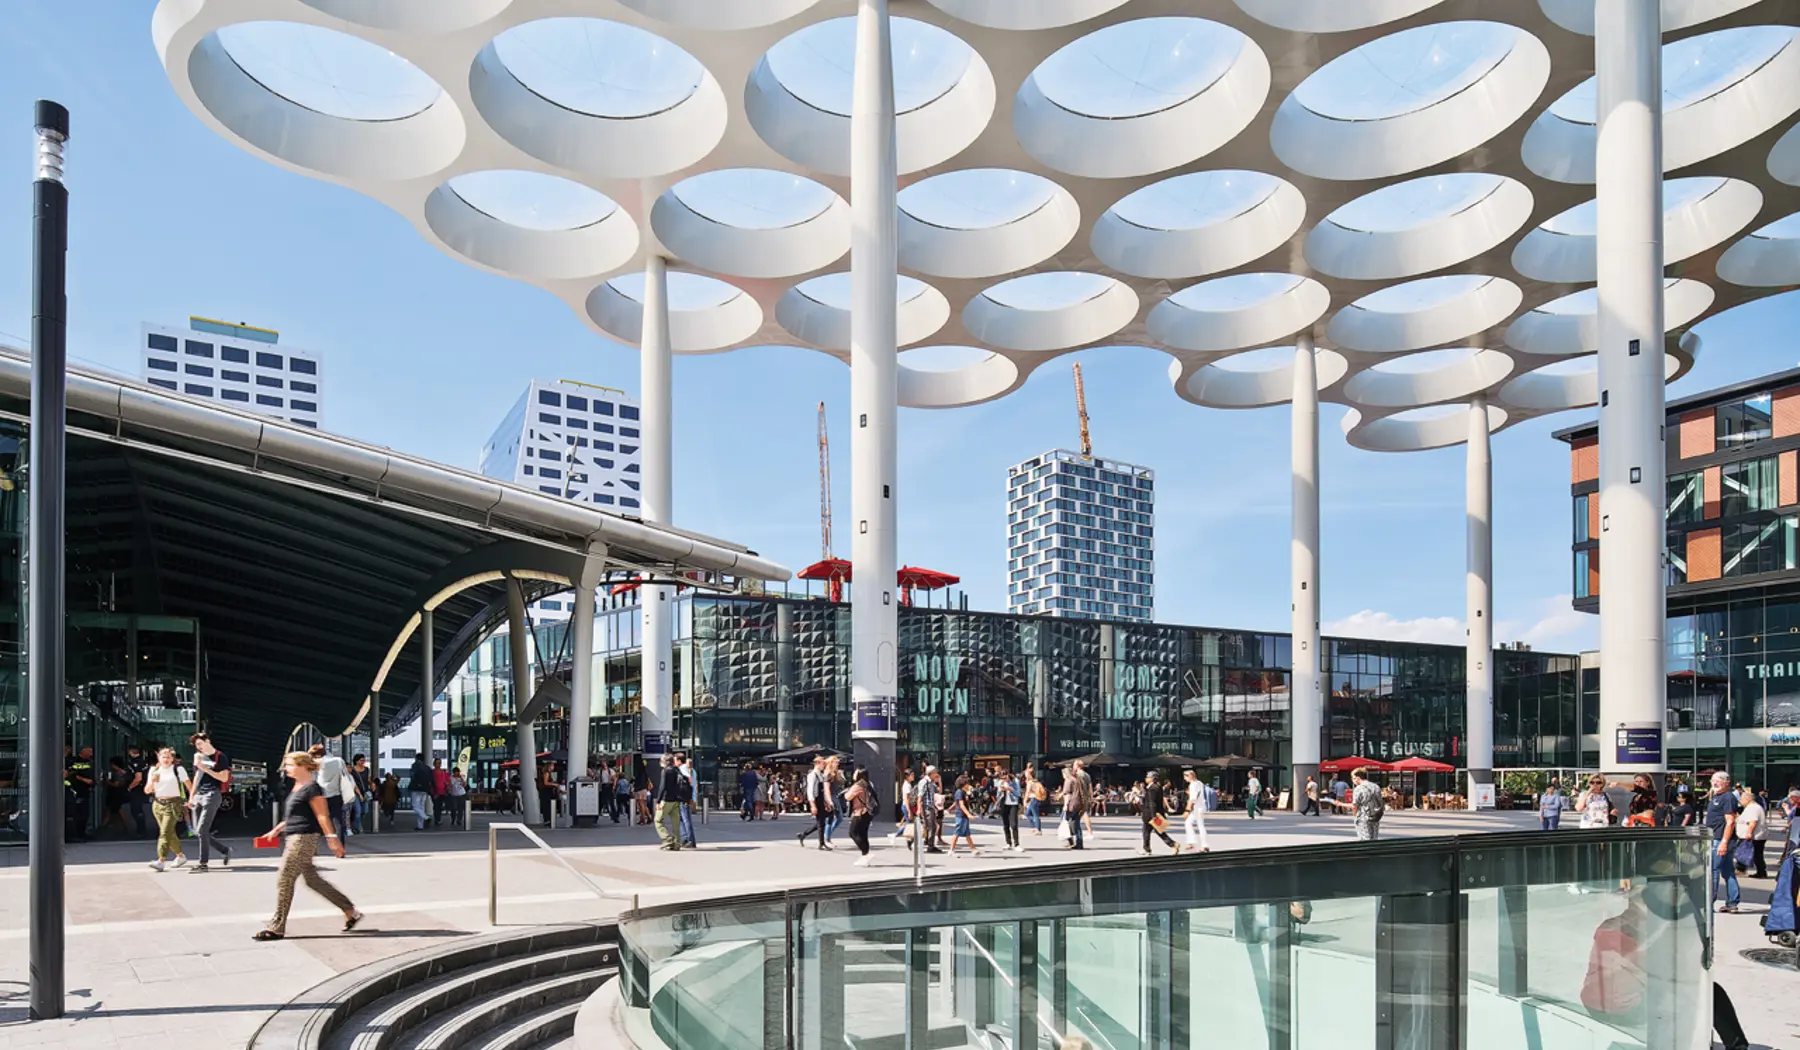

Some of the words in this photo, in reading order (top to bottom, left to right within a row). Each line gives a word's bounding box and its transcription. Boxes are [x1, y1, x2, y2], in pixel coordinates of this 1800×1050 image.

[915, 654, 959, 682] NOW
[1114, 664, 1160, 691] COME
[918, 687, 968, 715] OPEN
[1105, 694, 1163, 720] INSIDE
[1152, 742, 1193, 752] wagamma
